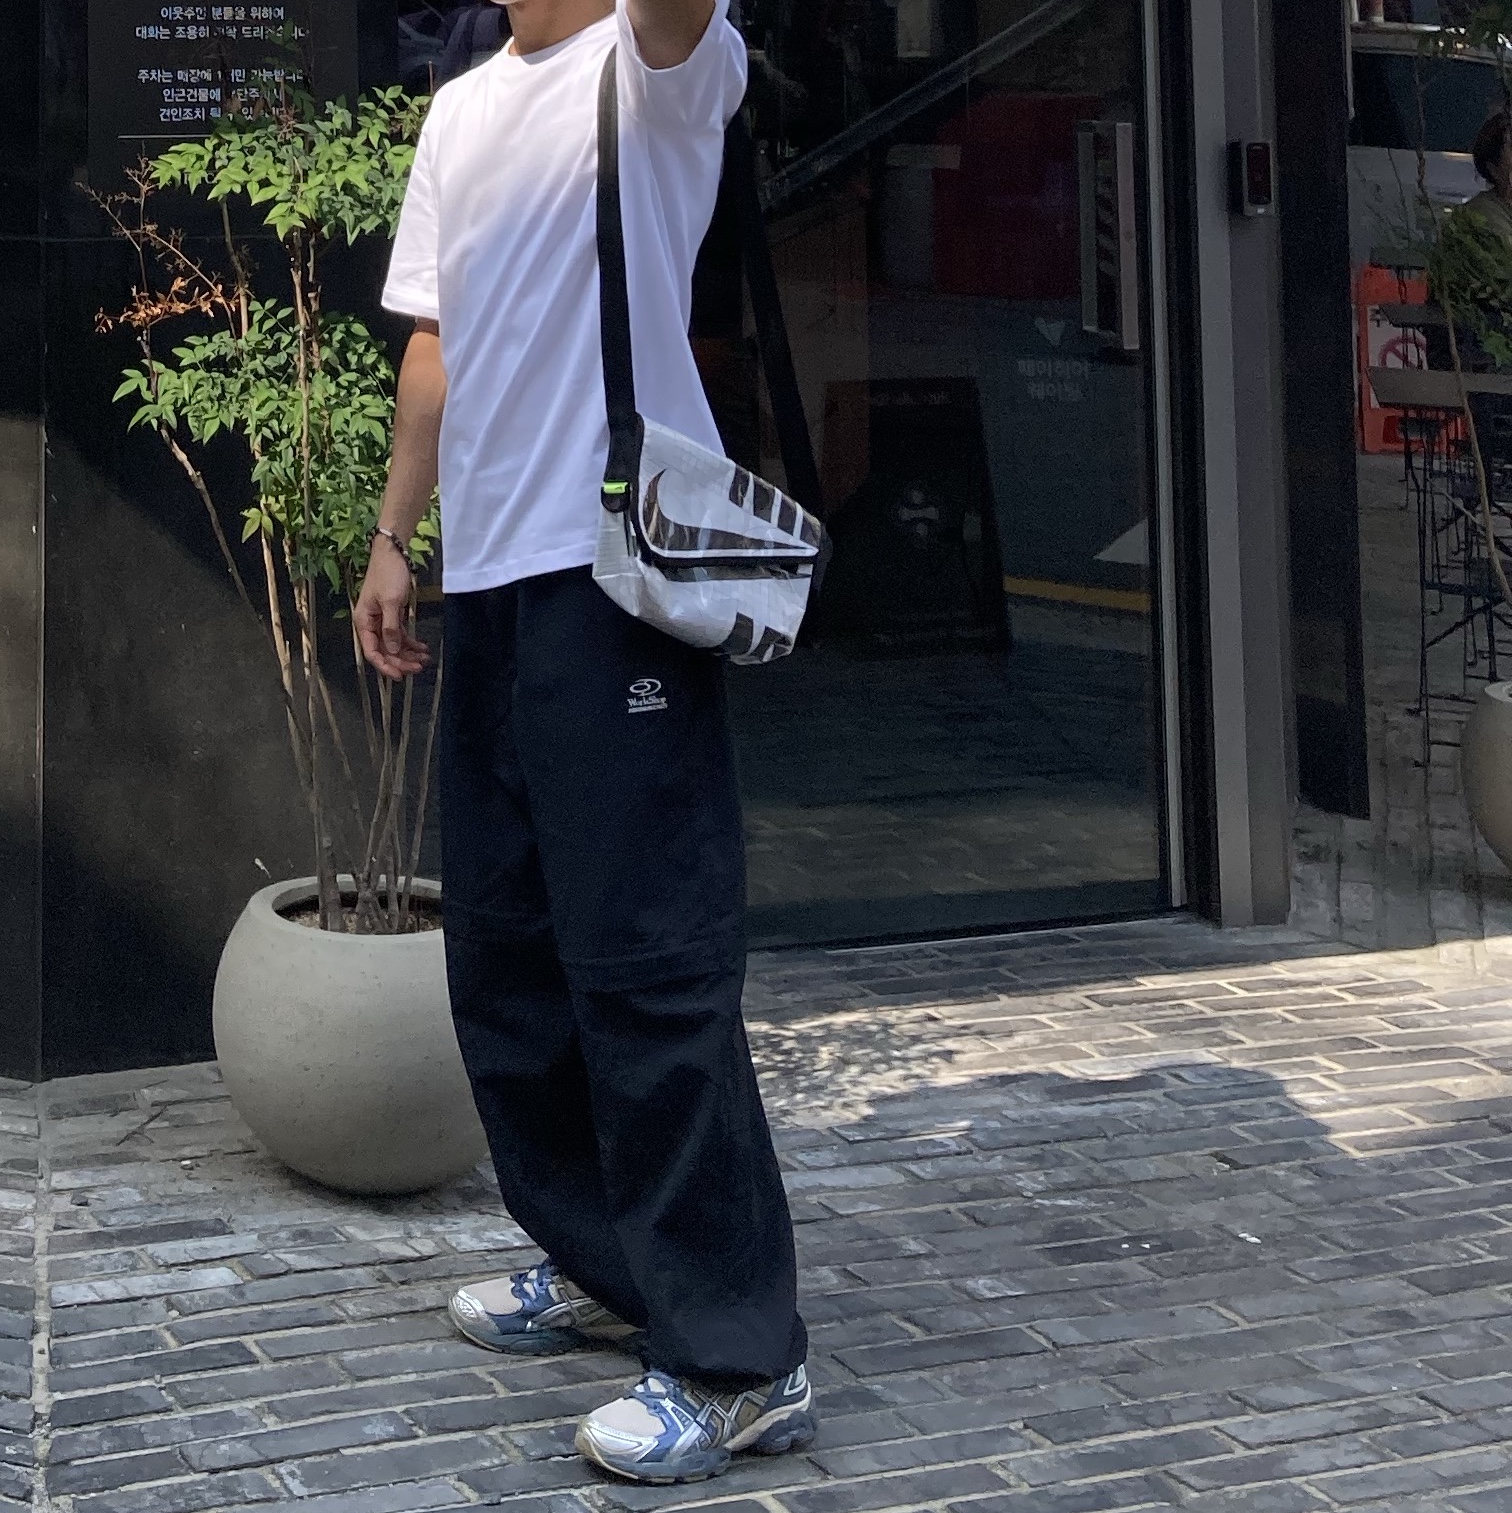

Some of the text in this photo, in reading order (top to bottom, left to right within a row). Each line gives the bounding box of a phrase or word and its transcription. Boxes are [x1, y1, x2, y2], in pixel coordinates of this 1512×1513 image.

[160, 6, 207, 21] 이웃주민
[250, 6, 285, 21] 위하여
[135, 25, 171, 40] 대화는
[174, 25, 210, 40] 조용히
[137, 69, 174, 84] 주차는
[163, 88, 221, 103] 인근건물에
[159, 107, 206, 122] 견인조치
